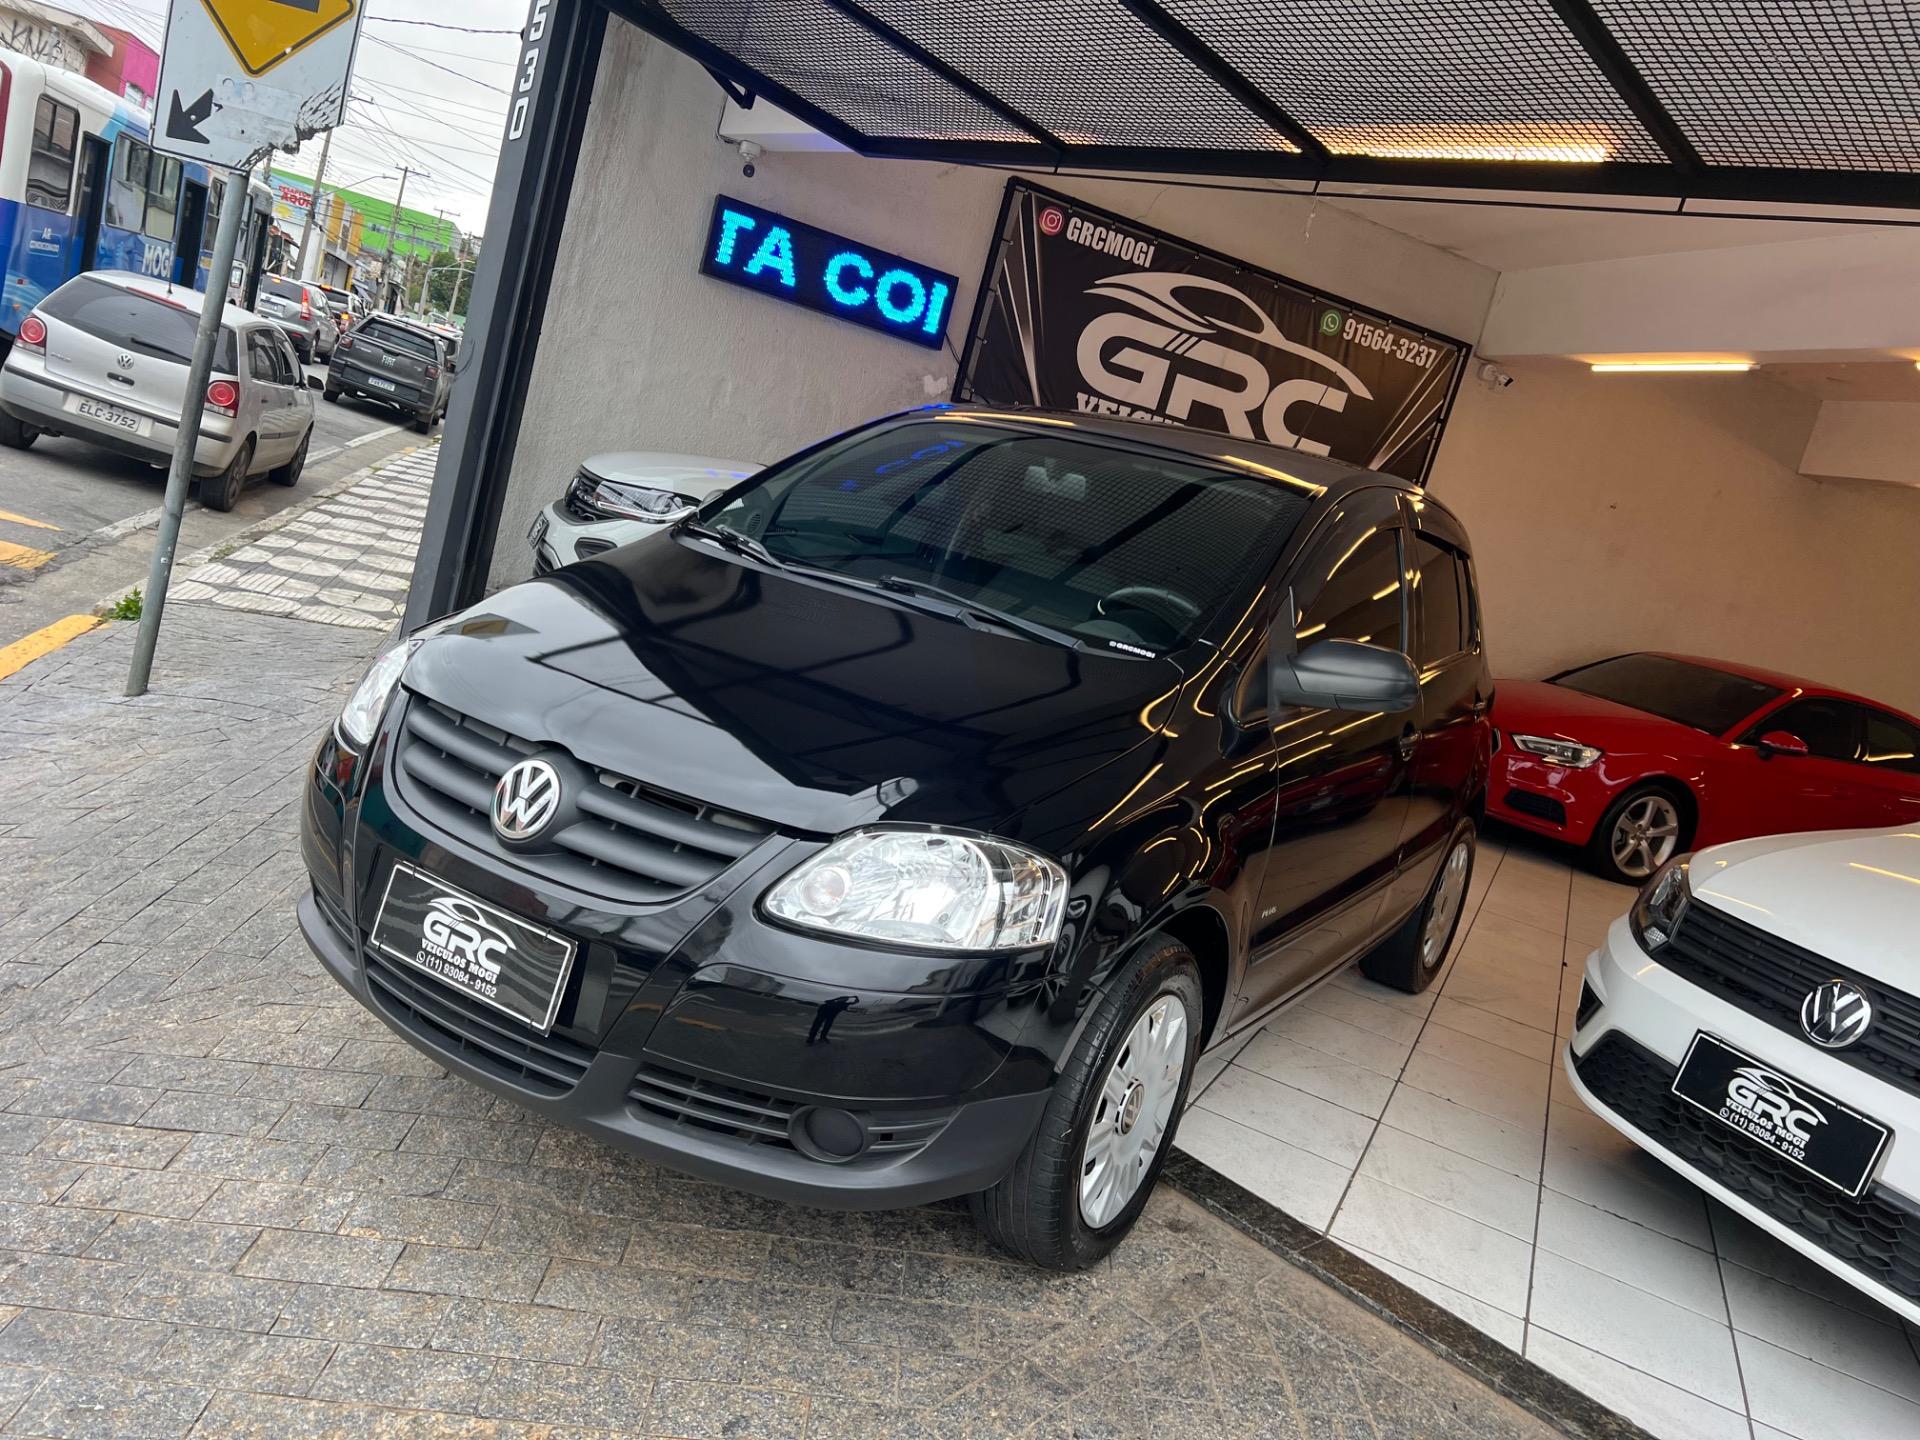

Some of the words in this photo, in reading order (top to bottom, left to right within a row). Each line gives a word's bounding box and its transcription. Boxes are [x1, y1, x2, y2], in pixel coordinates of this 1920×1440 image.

[1066, 216, 1155, 268] GRCMOGI
[1342, 318, 1438, 369] 91564-3237
[1076, 310, 1348, 457] GRC
[421, 938, 466, 967] VEICULOS
[469, 959, 497, 984] MOGI
[423, 910, 508, 974] GRC
[425, 954, 443, 972] (11)
[1725, 1097, 1773, 1129] VEICULOS
[1774, 1126, 1807, 1147] MOGI
[1727, 1077, 1819, 1142] GRC
[1729, 1112, 1747, 1131] (11)
[1748, 1122, 1775, 1145] 93084
[1781, 1140, 1805, 1161] 9152
